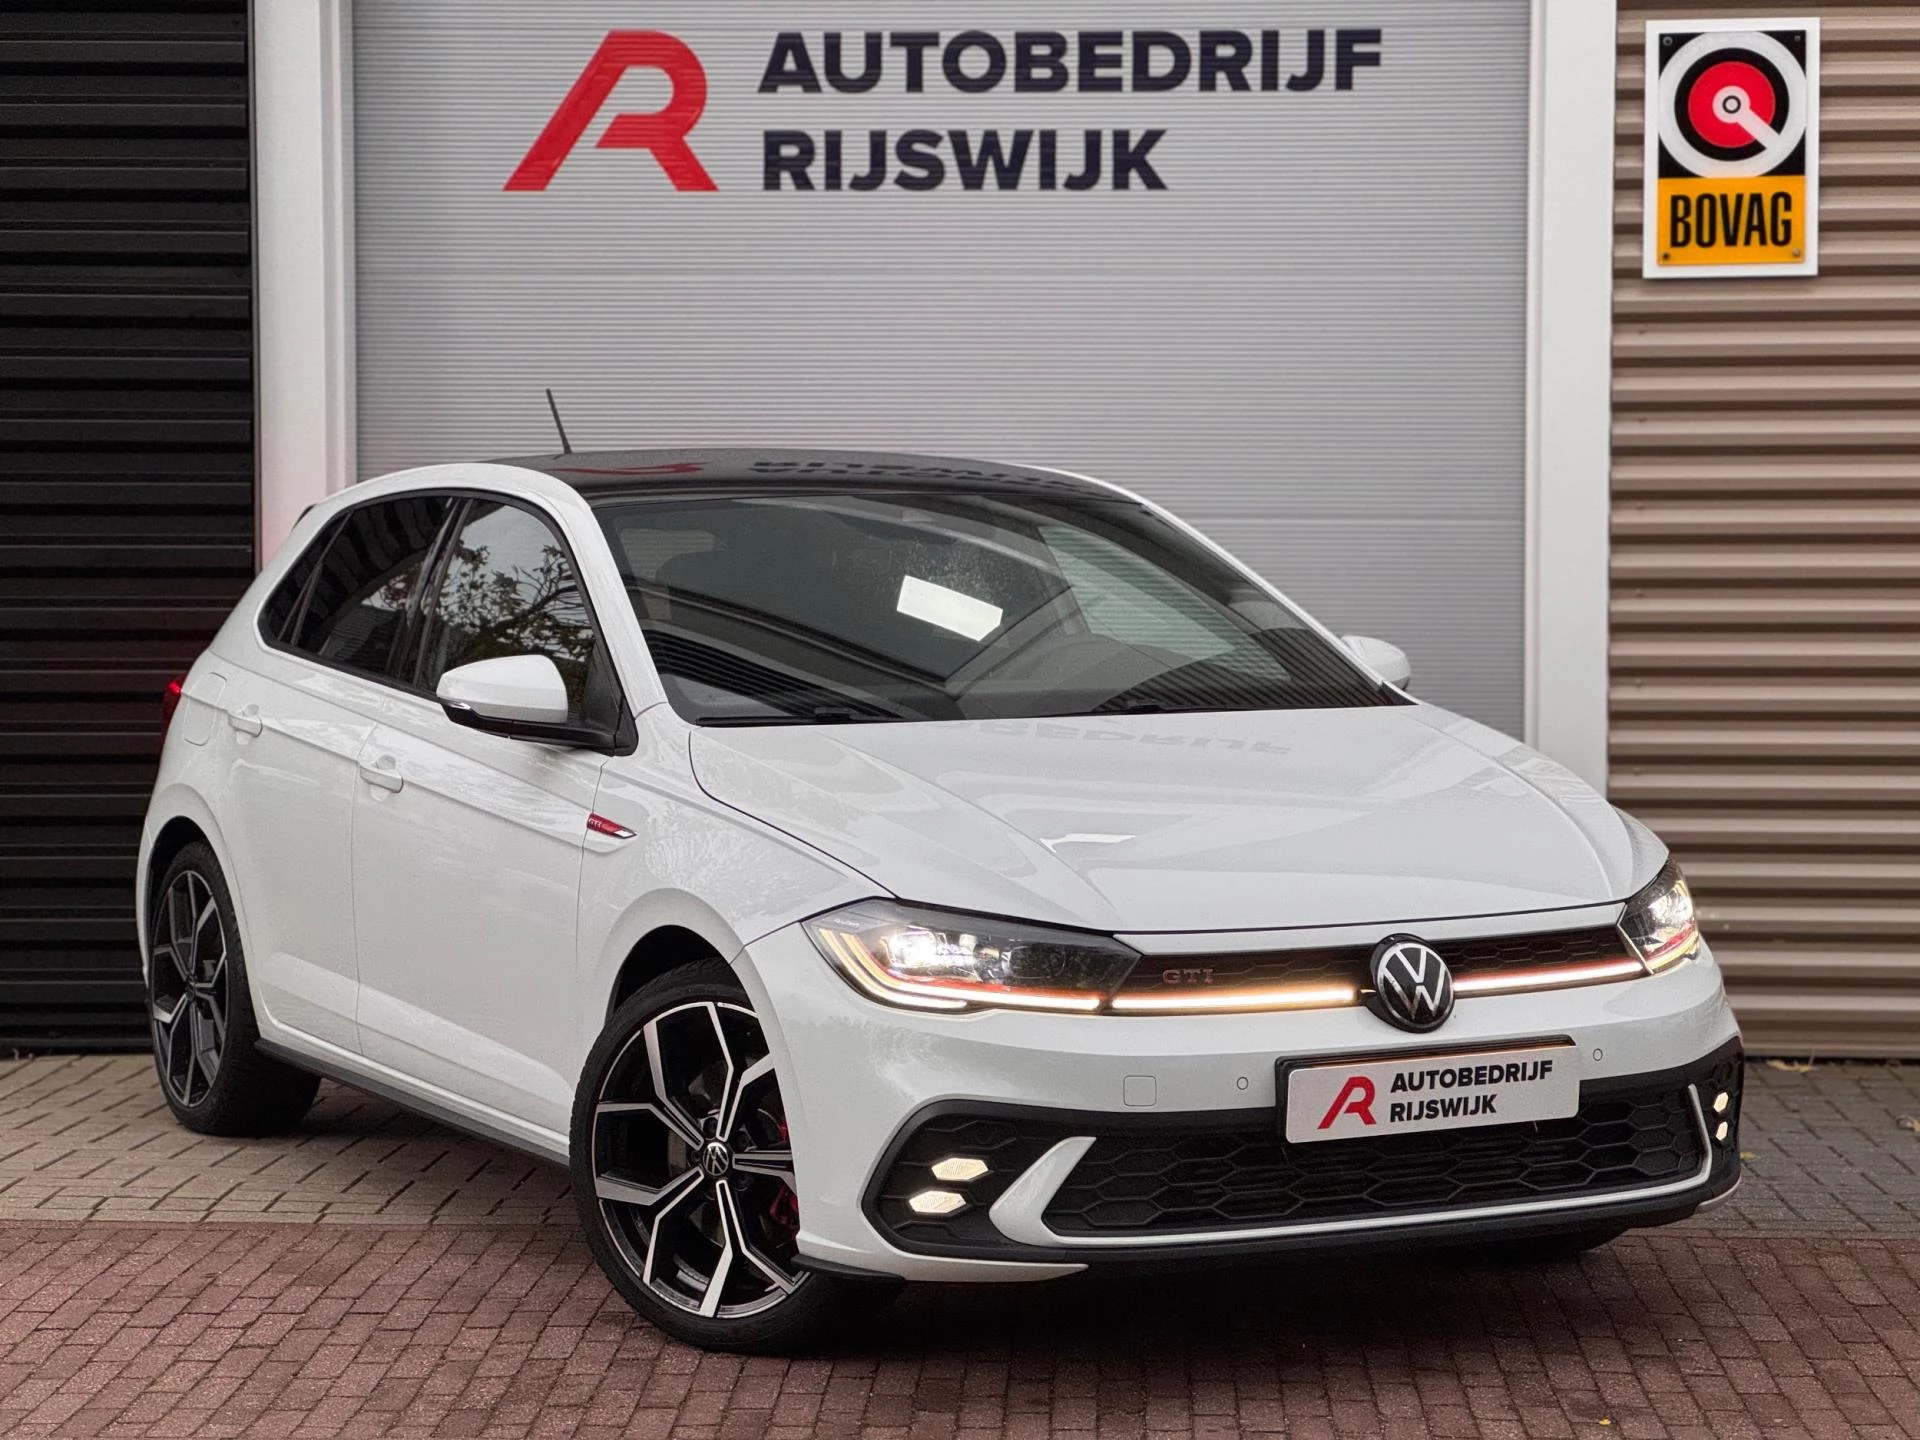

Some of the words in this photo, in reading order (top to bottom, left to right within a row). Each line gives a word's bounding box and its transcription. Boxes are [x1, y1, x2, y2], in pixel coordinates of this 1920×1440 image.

[758, 29, 1381, 93] AUTOBEDRIJF
[764, 130, 1167, 191] RIJSWIJK
[1670, 191, 1793, 249] BOVAG
[1162, 968, 1213, 984] GTI
[1390, 1060, 1553, 1094] AUTOBEDRIJF
[1390, 1094, 1497, 1123] RIJSWIJK
